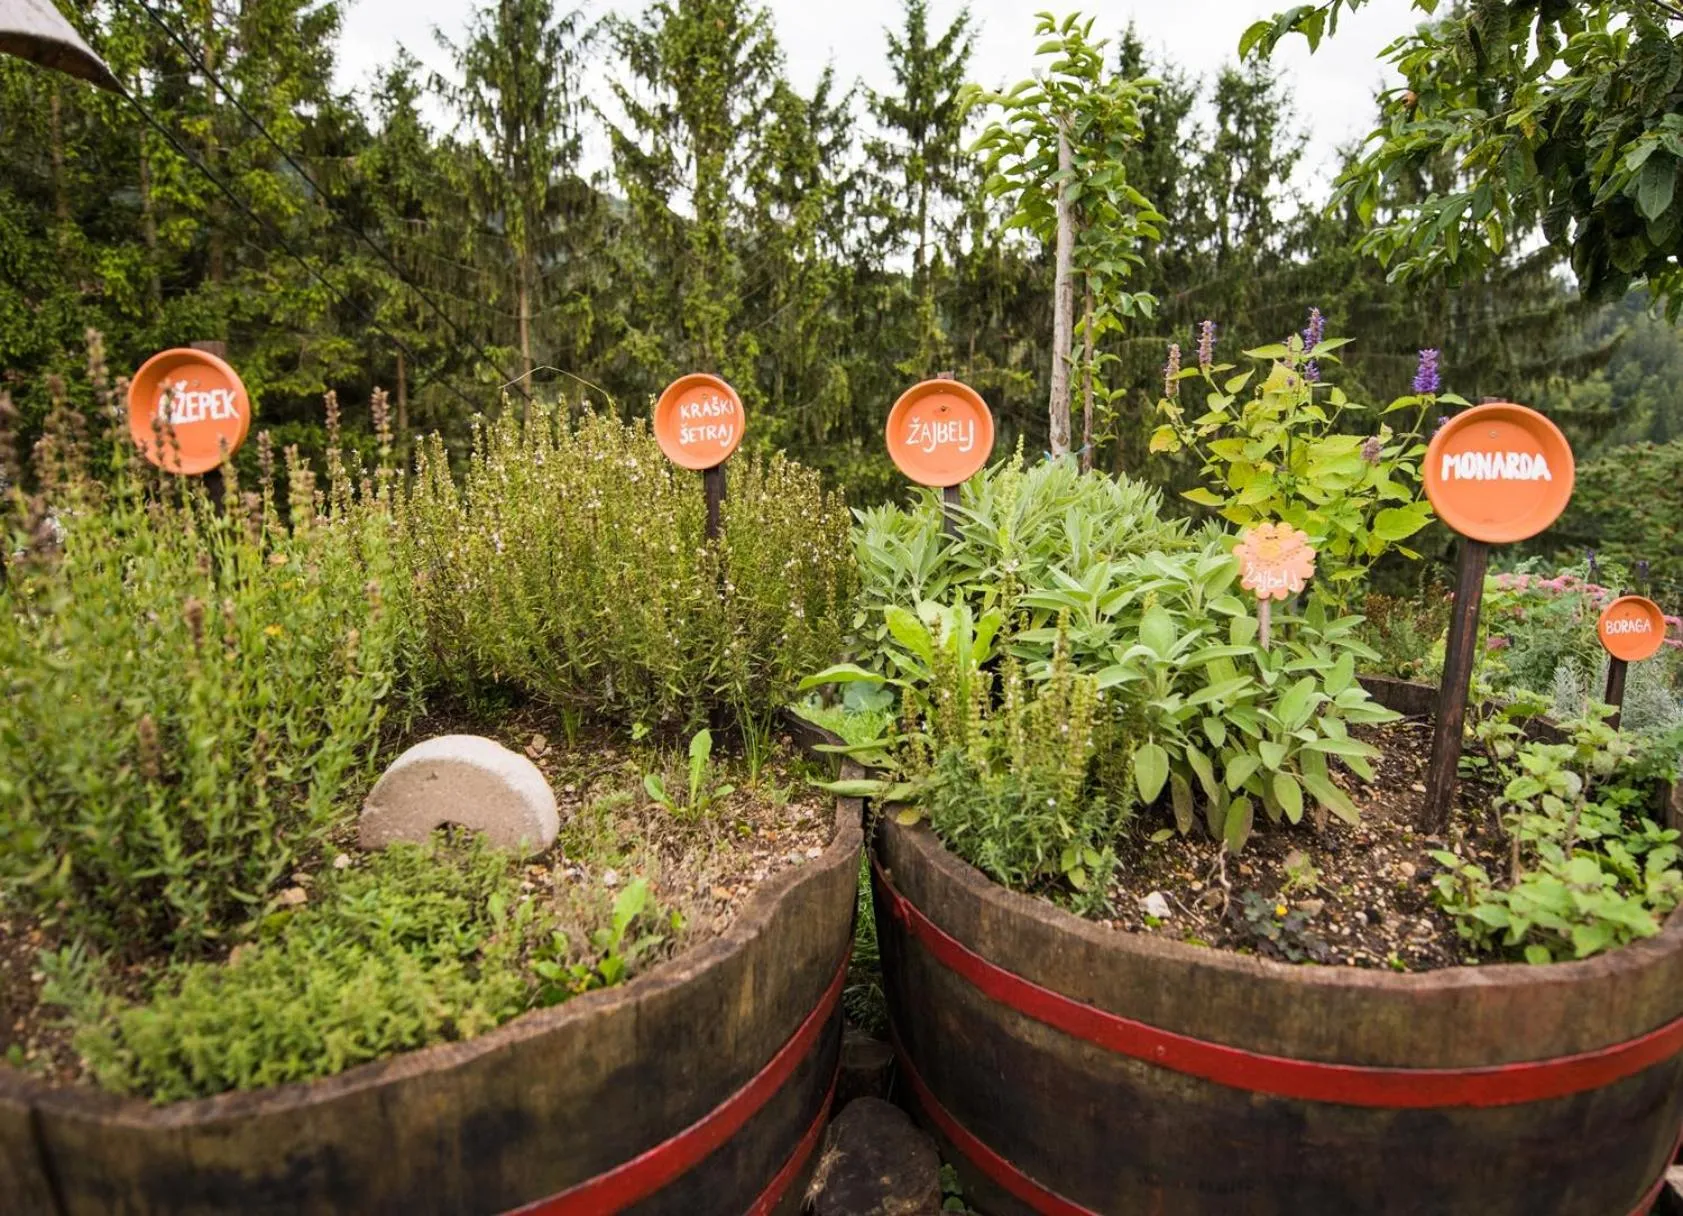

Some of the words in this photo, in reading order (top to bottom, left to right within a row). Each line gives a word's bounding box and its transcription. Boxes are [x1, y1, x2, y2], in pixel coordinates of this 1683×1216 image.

[680, 396, 734, 419] KRAŠKI
[679, 423, 734, 447] ŠETRAJ
[905, 416, 974, 453] ŽAJBELJ
[1441, 451, 1552, 481] MONARDA
[1606, 618, 1652, 635] BORAGA
